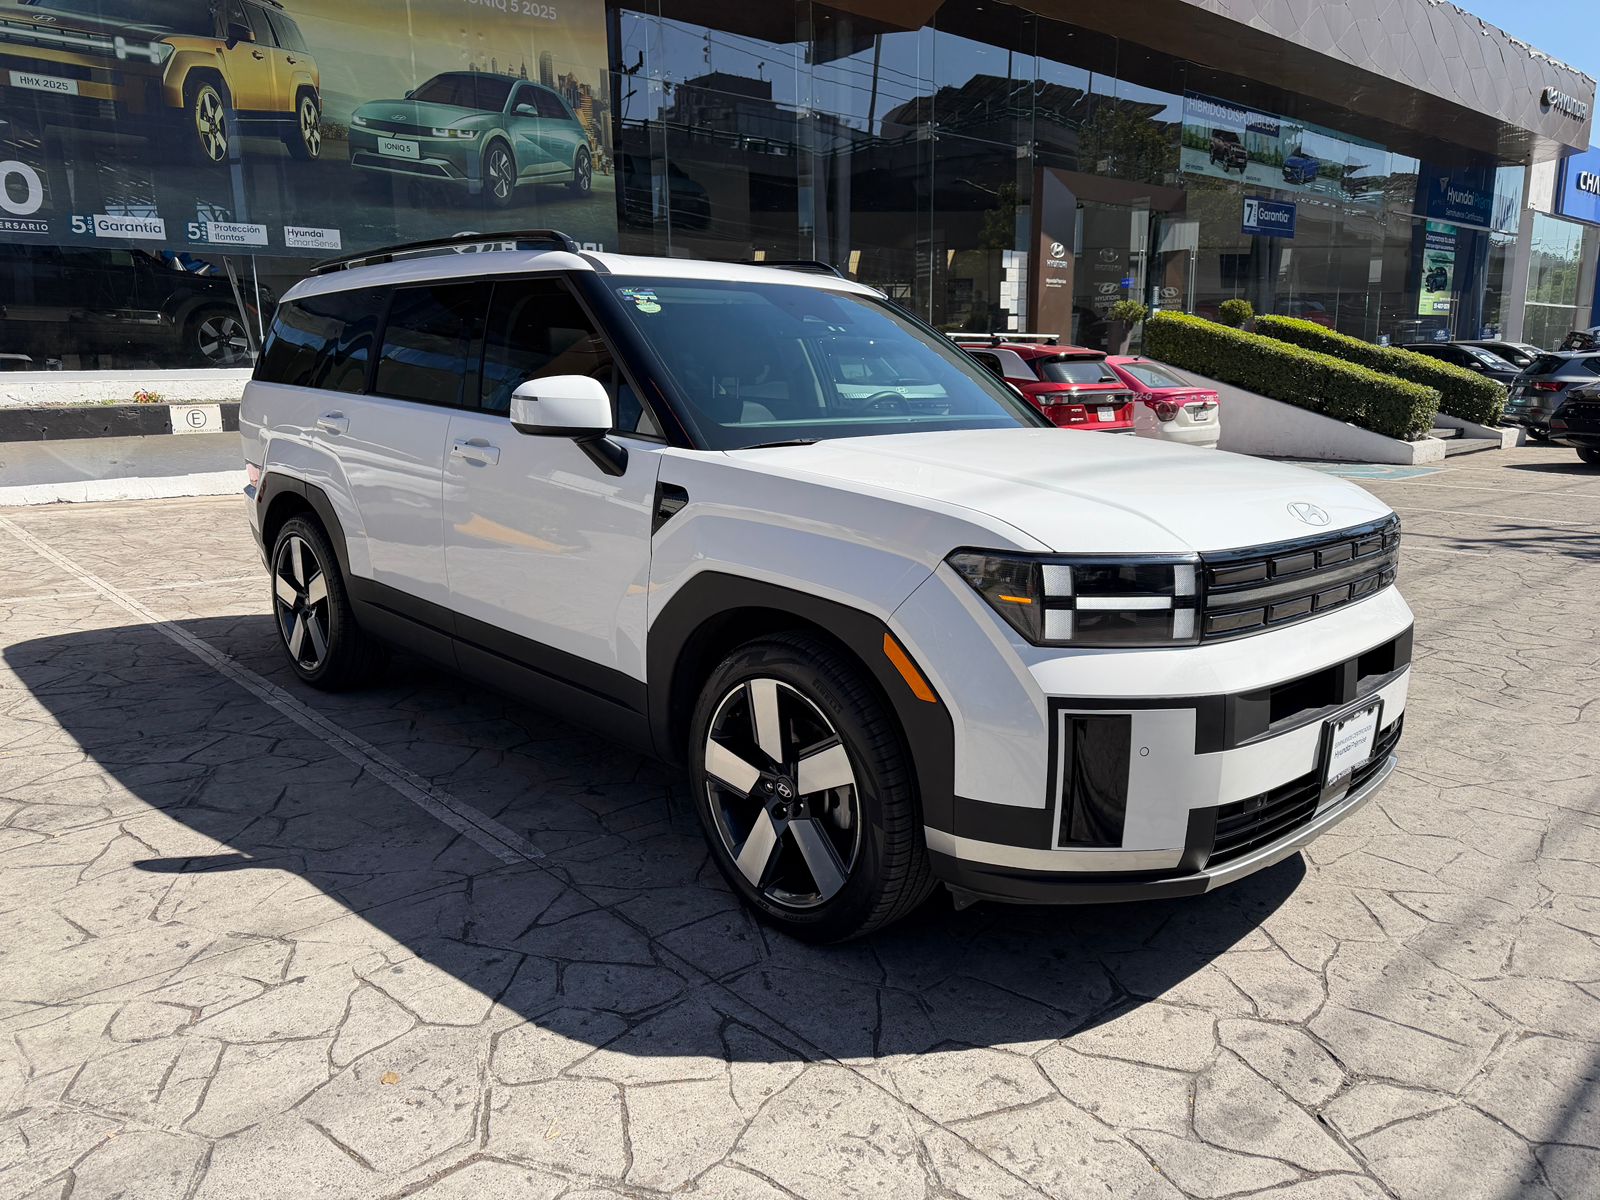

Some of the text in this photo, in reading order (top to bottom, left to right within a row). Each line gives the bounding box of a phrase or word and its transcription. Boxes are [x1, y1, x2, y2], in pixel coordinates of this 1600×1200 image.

[522, 1, 557, 20] 2025
[20, 76, 69, 91] HMX 2025
[384, 142, 411, 153] IONIQ 5
[1246, 202, 1254, 224] 7
[72, 215, 87, 234] 5
[98, 219, 162, 234] Garantía
[187, 222, 200, 240] 5
[213, 223, 261, 234] Protección
[287, 228, 324, 239] Hyundai
[288, 238, 339, 248] SmartSense
[191, 412, 202, 425] E
